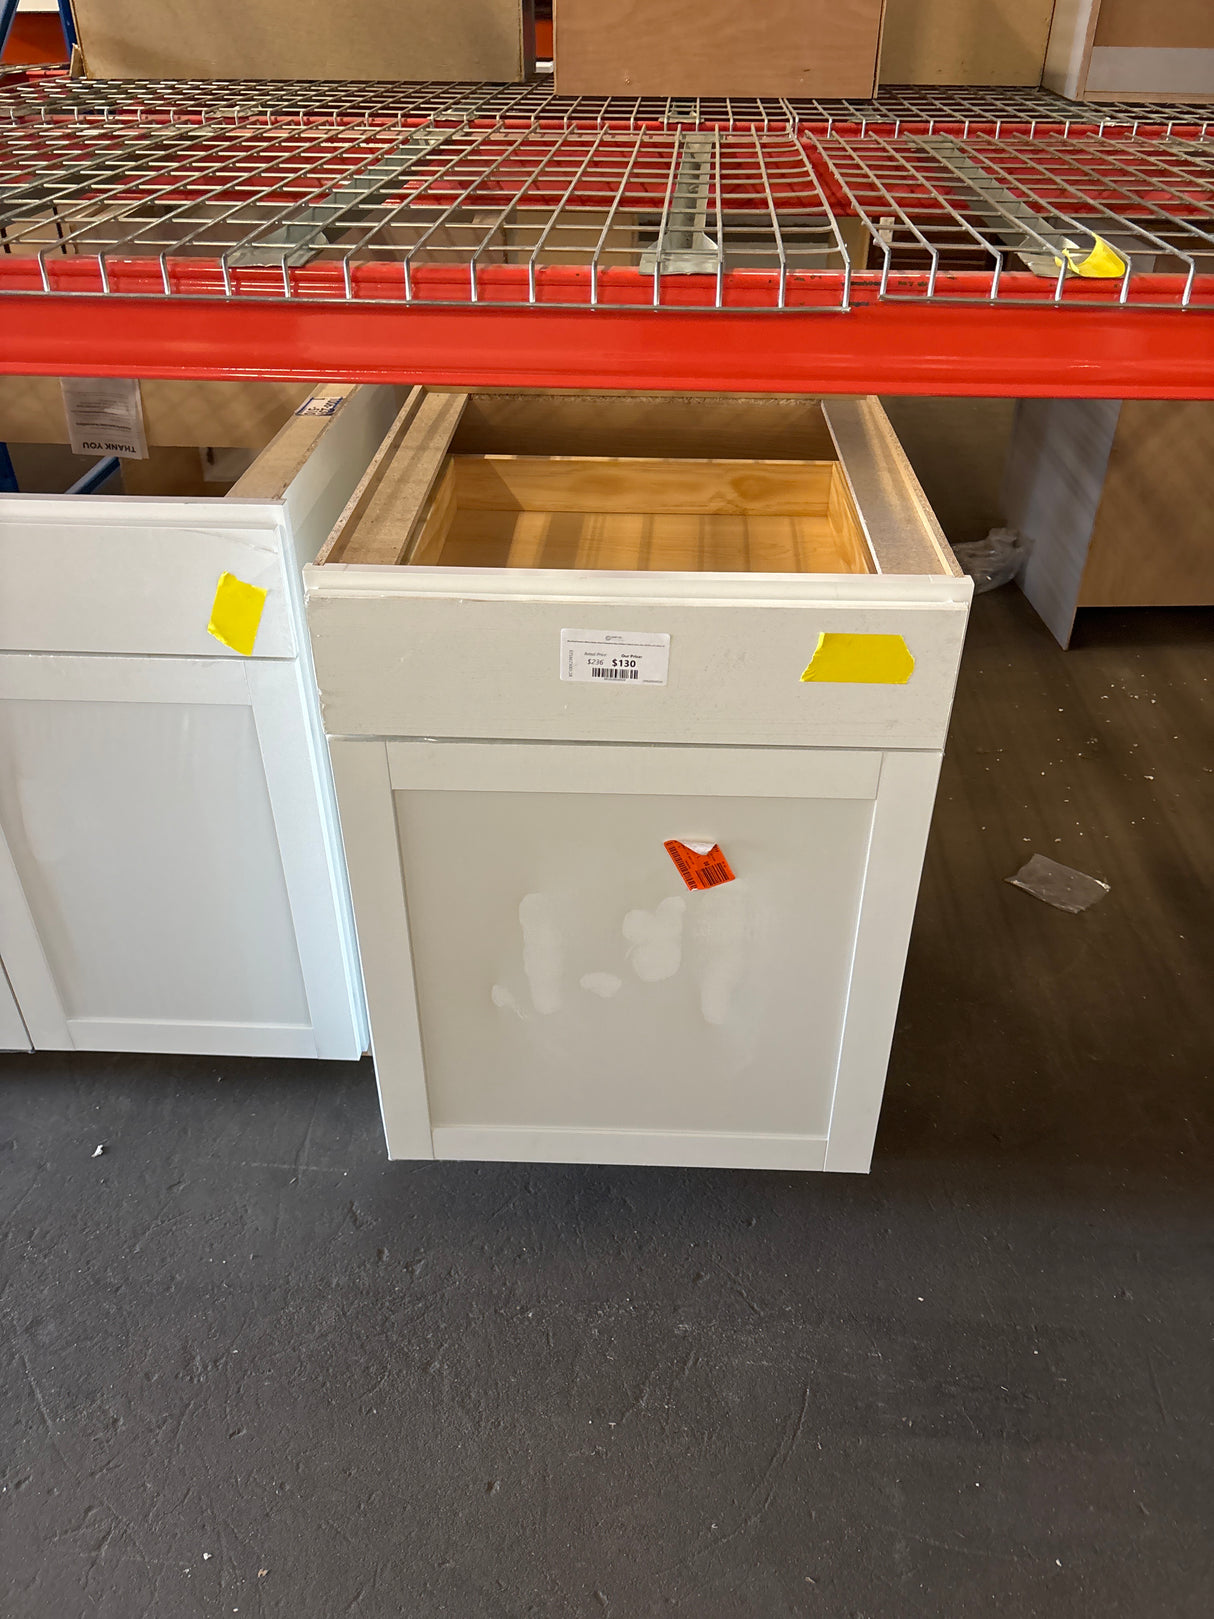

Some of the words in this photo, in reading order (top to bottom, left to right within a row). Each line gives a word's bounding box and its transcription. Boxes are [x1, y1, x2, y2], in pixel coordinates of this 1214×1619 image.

[83, 441, 103, 450] YOU
[105, 443, 136, 453] THANK
[587, 658, 604, 666] $236
[612, 658, 636, 668] $130
